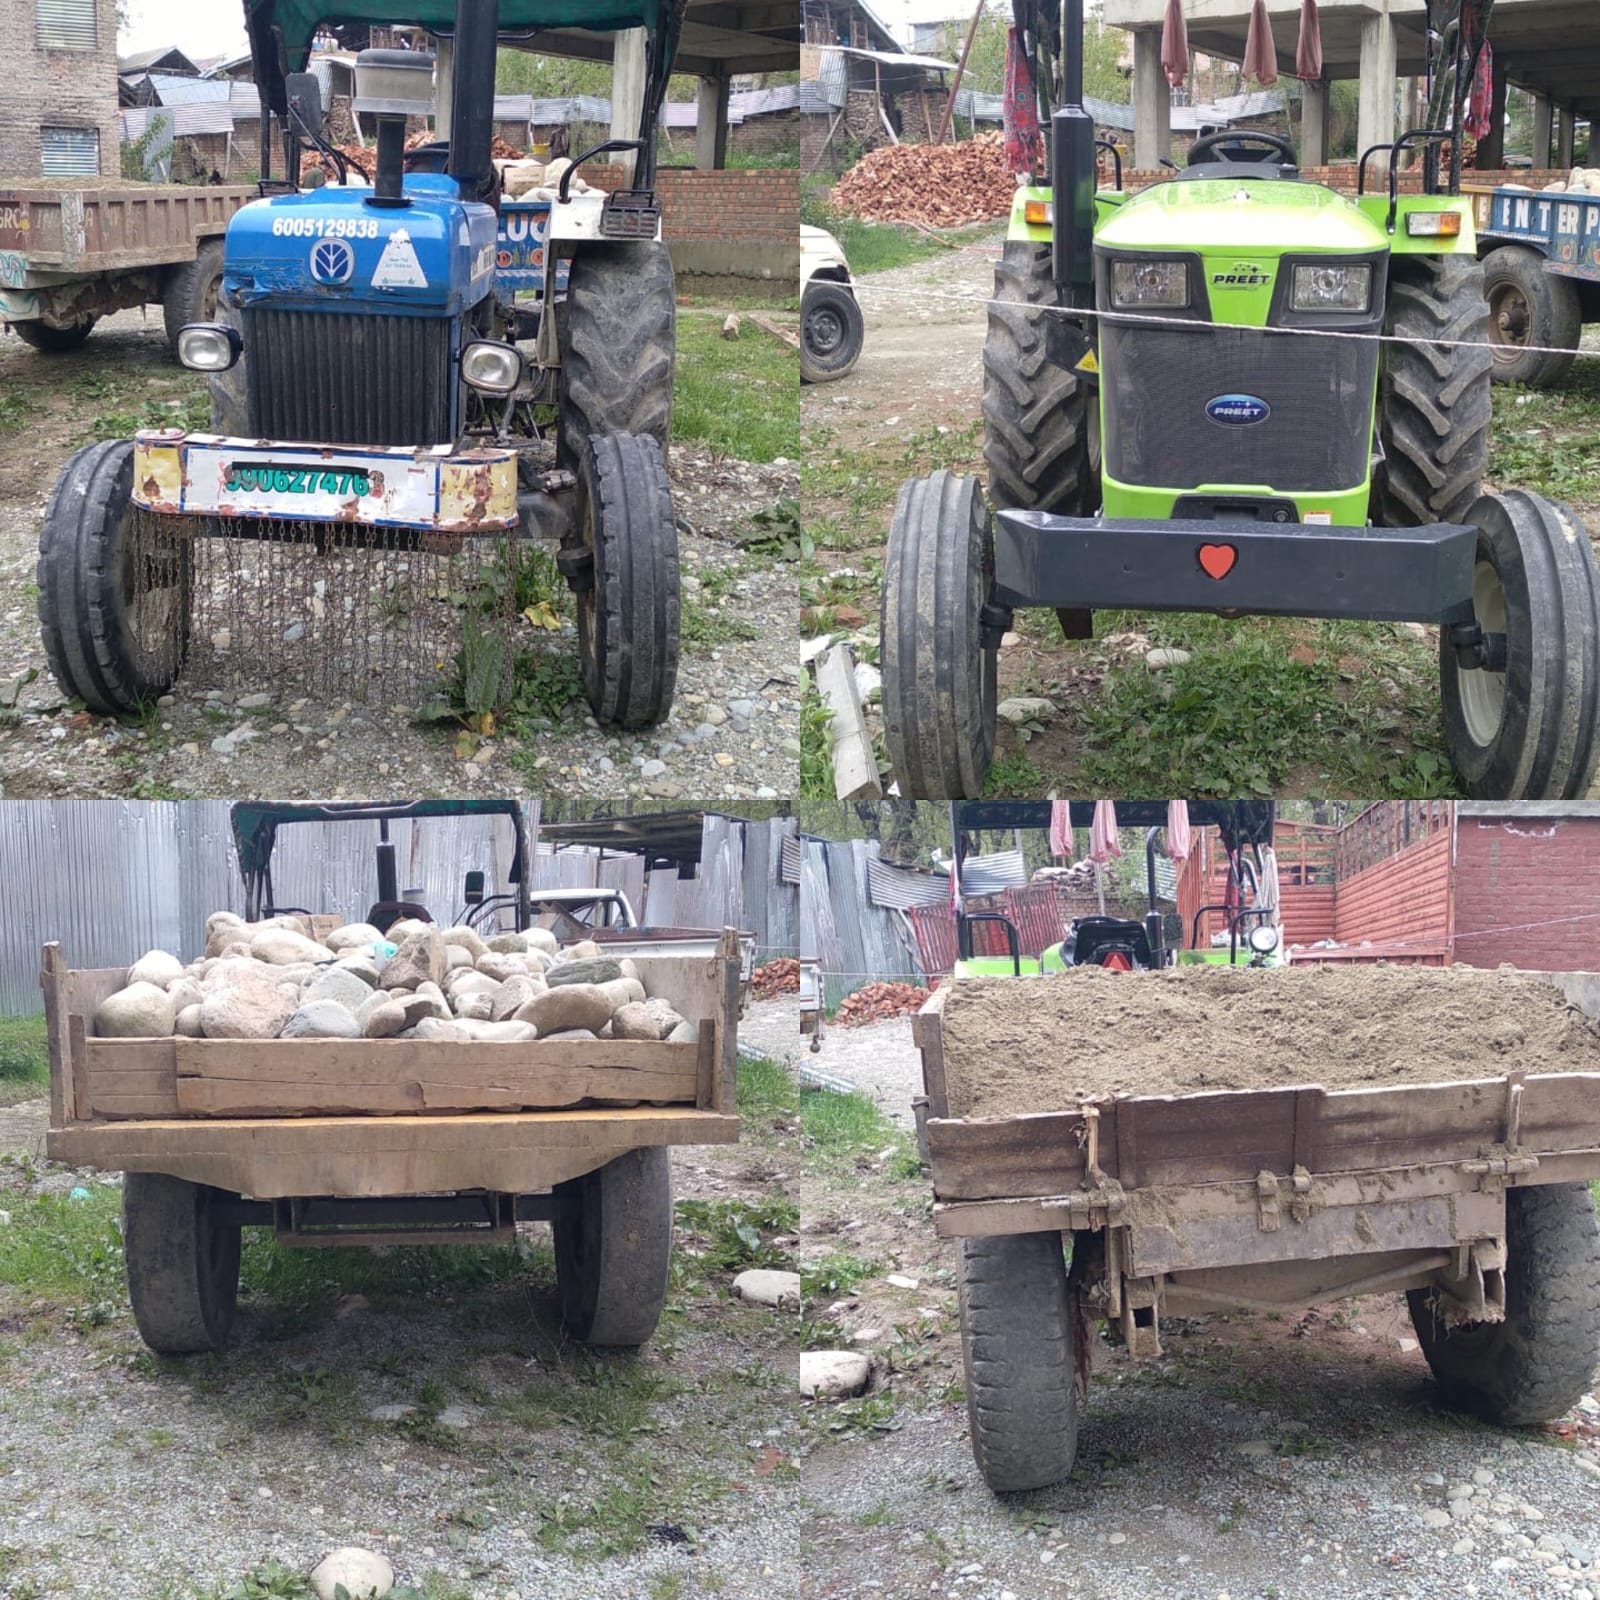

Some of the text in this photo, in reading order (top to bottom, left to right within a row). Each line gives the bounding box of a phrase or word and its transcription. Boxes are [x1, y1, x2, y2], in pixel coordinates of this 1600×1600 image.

[1502, 197, 1600, 236] ENTERP
[272, 217, 378, 239] 6005129838
[1214, 274, 1270, 284] PREET
[1214, 407, 1261, 416] PREET
